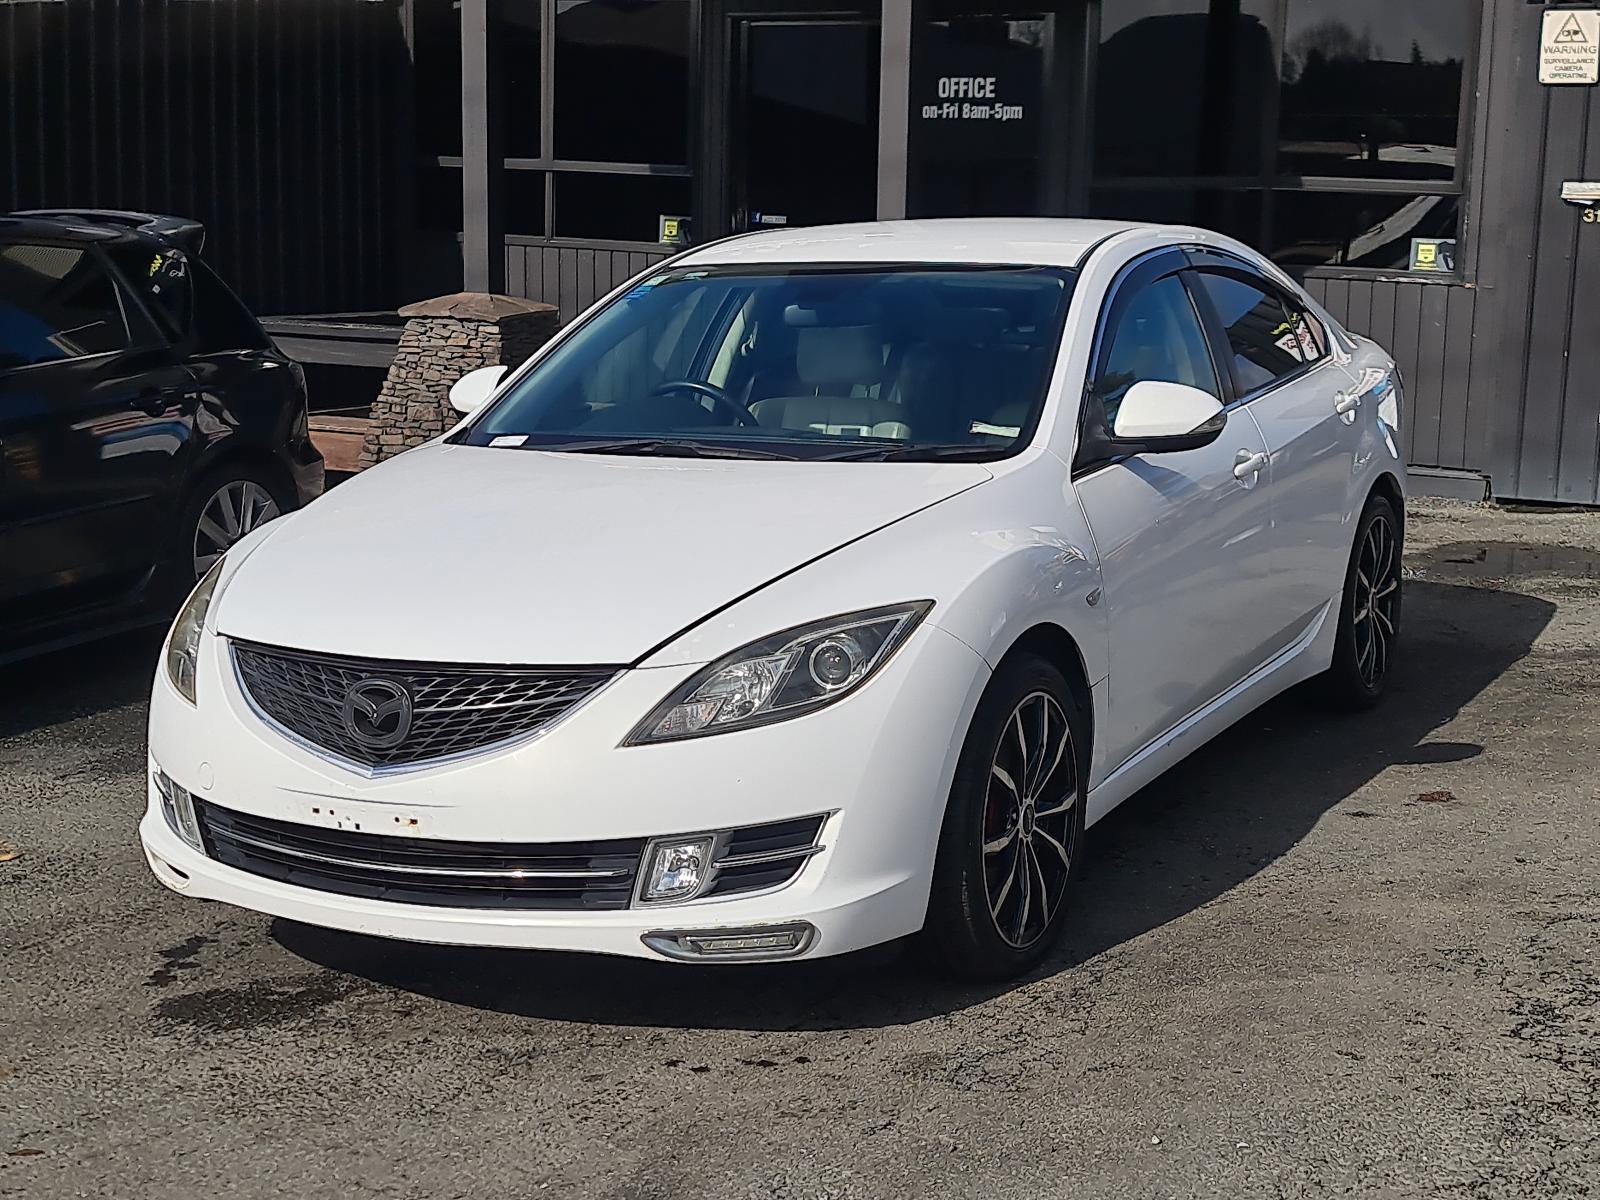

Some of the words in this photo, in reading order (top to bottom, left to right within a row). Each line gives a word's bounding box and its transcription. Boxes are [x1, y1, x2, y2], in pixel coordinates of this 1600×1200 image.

[1543, 45, 1597, 54] WARNING
[938, 76, 997, 99] OFFICE
[922, 102, 959, 119] on-Fri
[962, 102, 1023, 122] 8am-5pm
